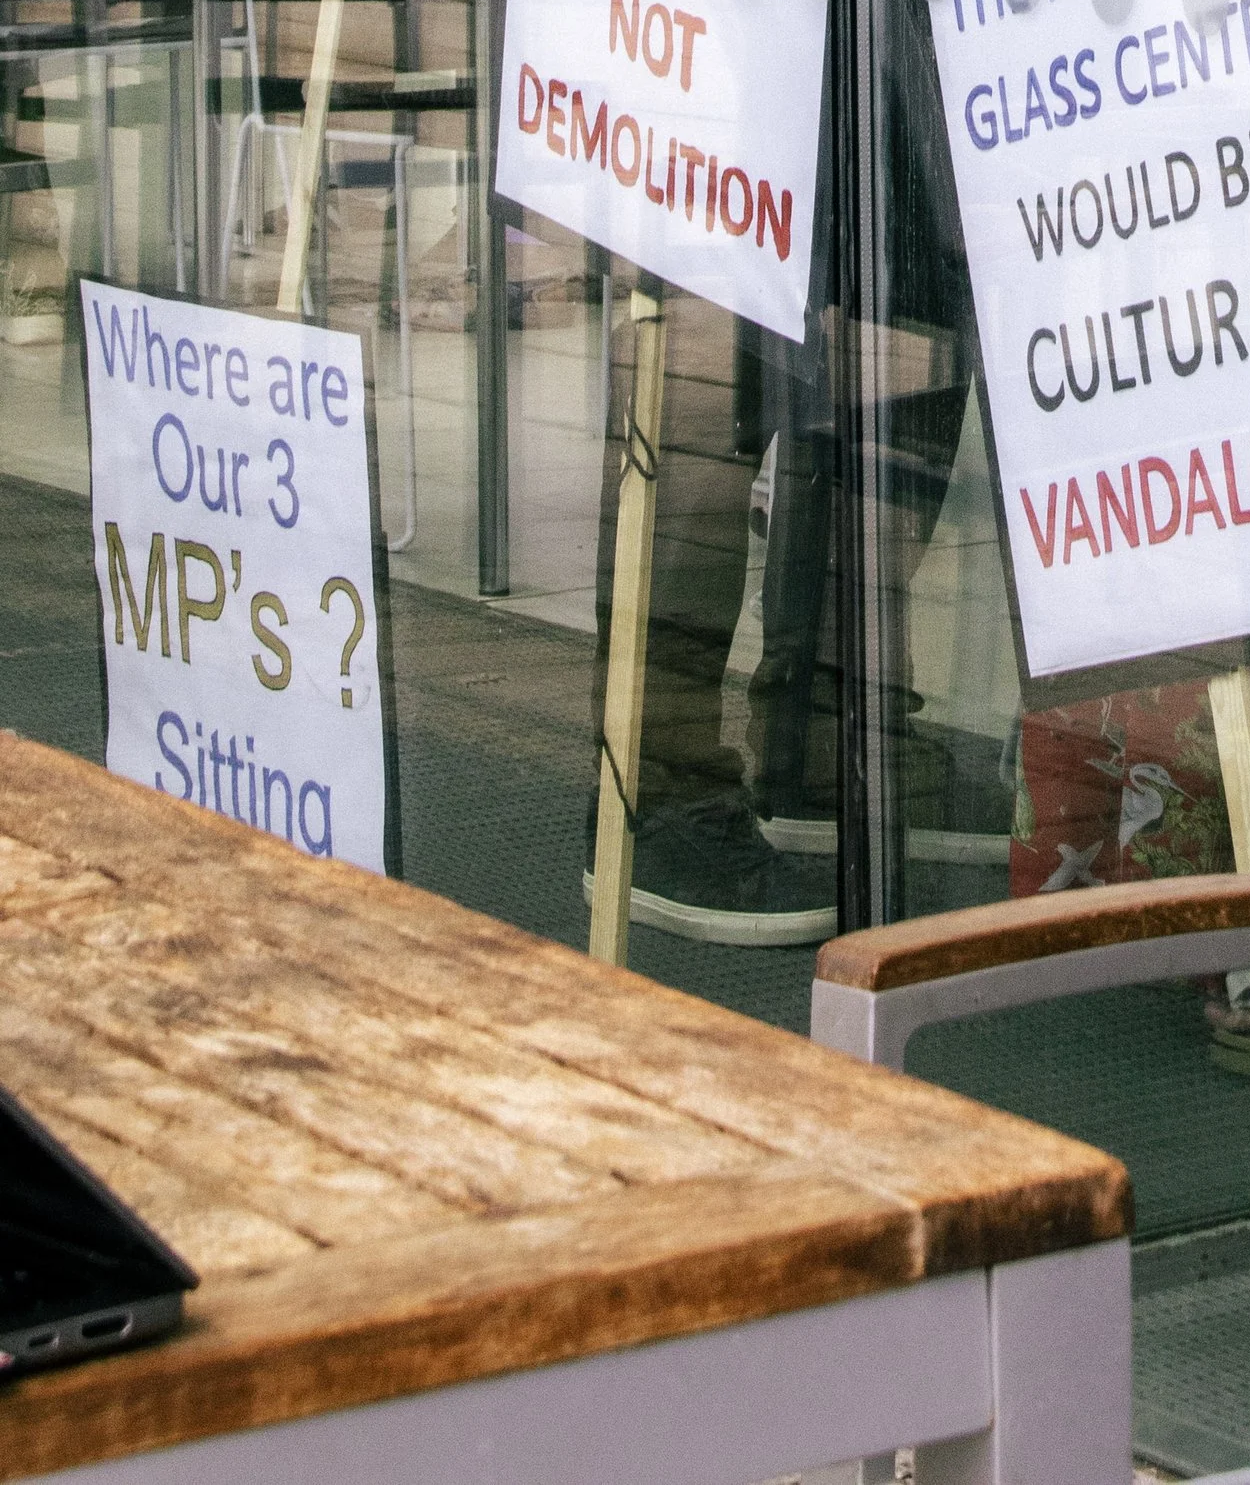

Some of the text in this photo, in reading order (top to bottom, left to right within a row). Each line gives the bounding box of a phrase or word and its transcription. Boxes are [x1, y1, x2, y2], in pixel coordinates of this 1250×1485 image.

[518, 62, 794, 262] DEMOLITION
[964, 47, 1103, 151] GLASS
[1016, 150, 1202, 262] WOULD
[93, 299, 349, 427] Where are
[152, 412, 301, 529] Our 3
[104, 521, 366, 709] MP's ?
[155, 710, 333, 858] Sitting
